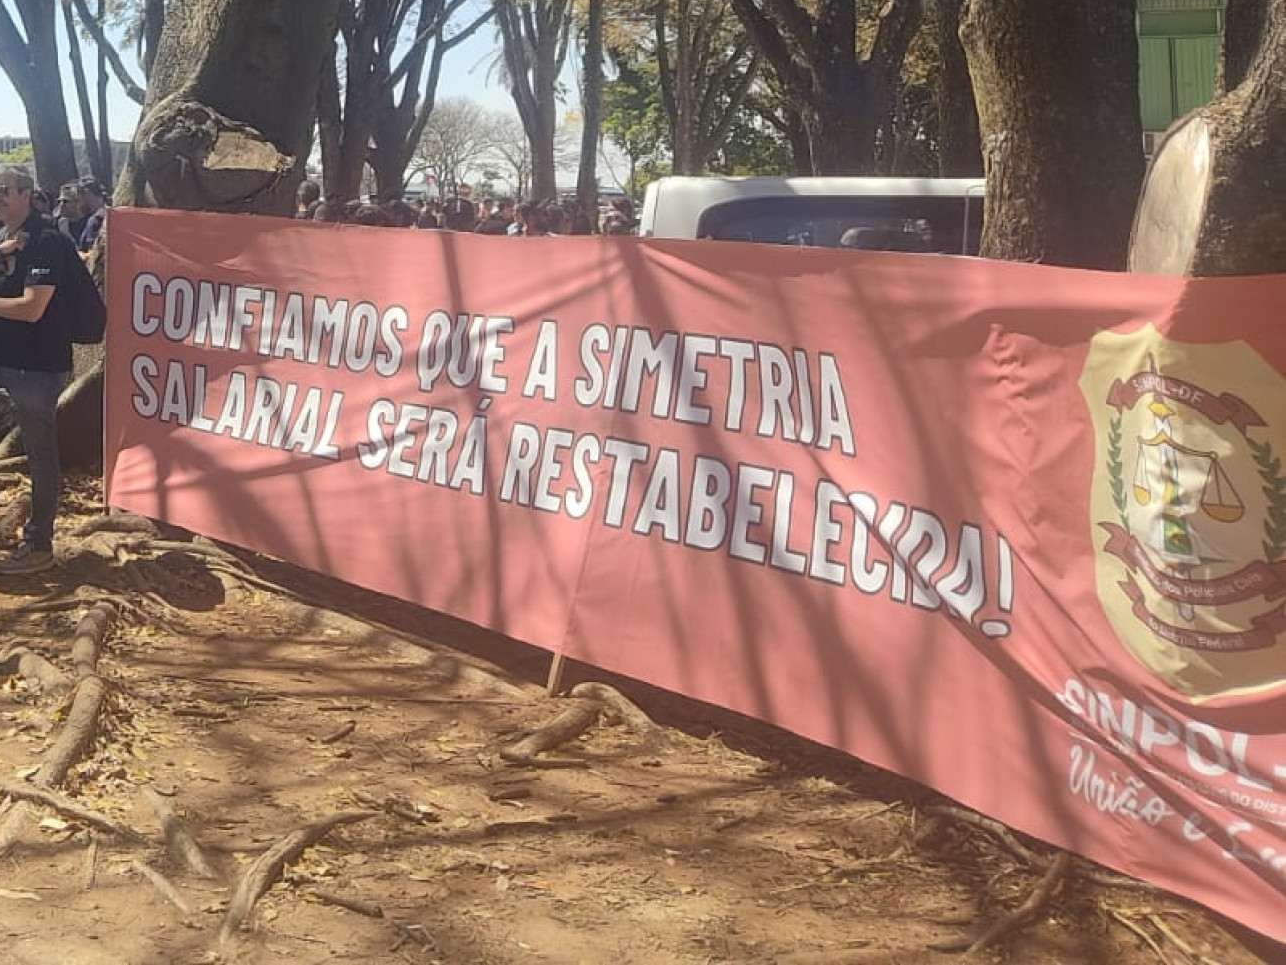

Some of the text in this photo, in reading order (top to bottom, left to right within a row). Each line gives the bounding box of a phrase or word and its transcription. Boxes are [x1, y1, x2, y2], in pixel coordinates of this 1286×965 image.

[132, 271, 856, 456] CONFIAMOS QUE A SIMETRIA
[131, 353, 345, 460] SALARIAL
[357, 396, 493, 496] SERÁ
[500, 422, 1013, 638] RESTABELECIDA!
[1070, 744, 1175, 827] União
